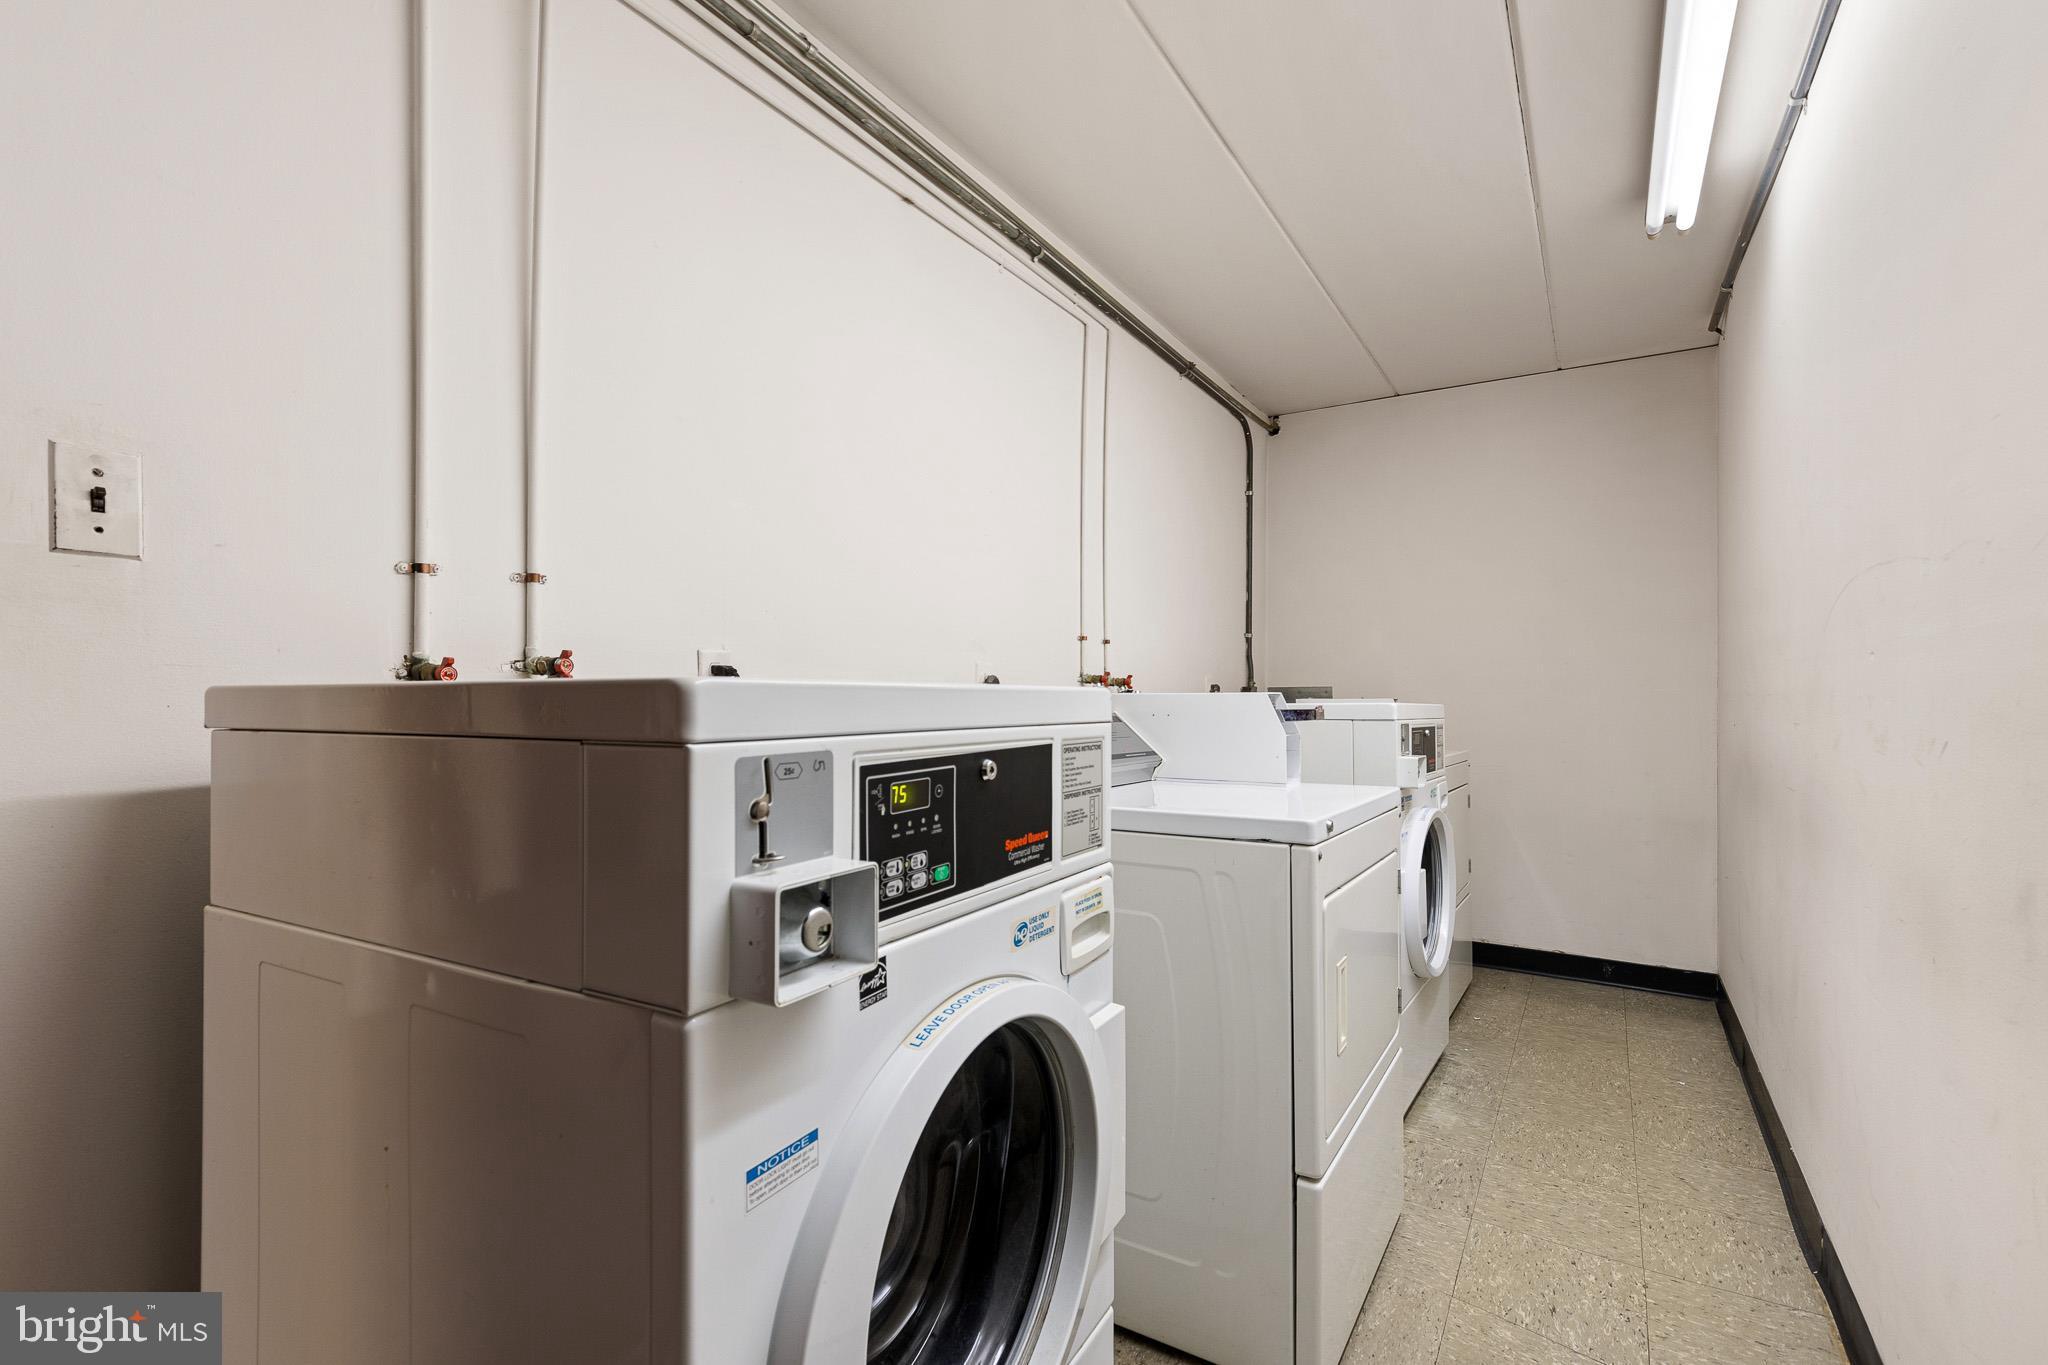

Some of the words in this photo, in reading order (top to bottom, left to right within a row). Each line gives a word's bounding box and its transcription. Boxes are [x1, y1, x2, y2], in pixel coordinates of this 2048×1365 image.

[892, 784, 907, 804] 75
[1005, 834, 1027, 851] Speed
[1029, 915, 1039, 925] USE
[1039, 911, 1050, 921] ONLY
[1029, 922, 1045, 934] LIQUID
[1029, 926, 1055, 943] DETERGENT
[909, 1015, 947, 1048] LEAVE
[943, 995, 975, 1016] DOOR
[757, 1135, 810, 1176] NOTICE
